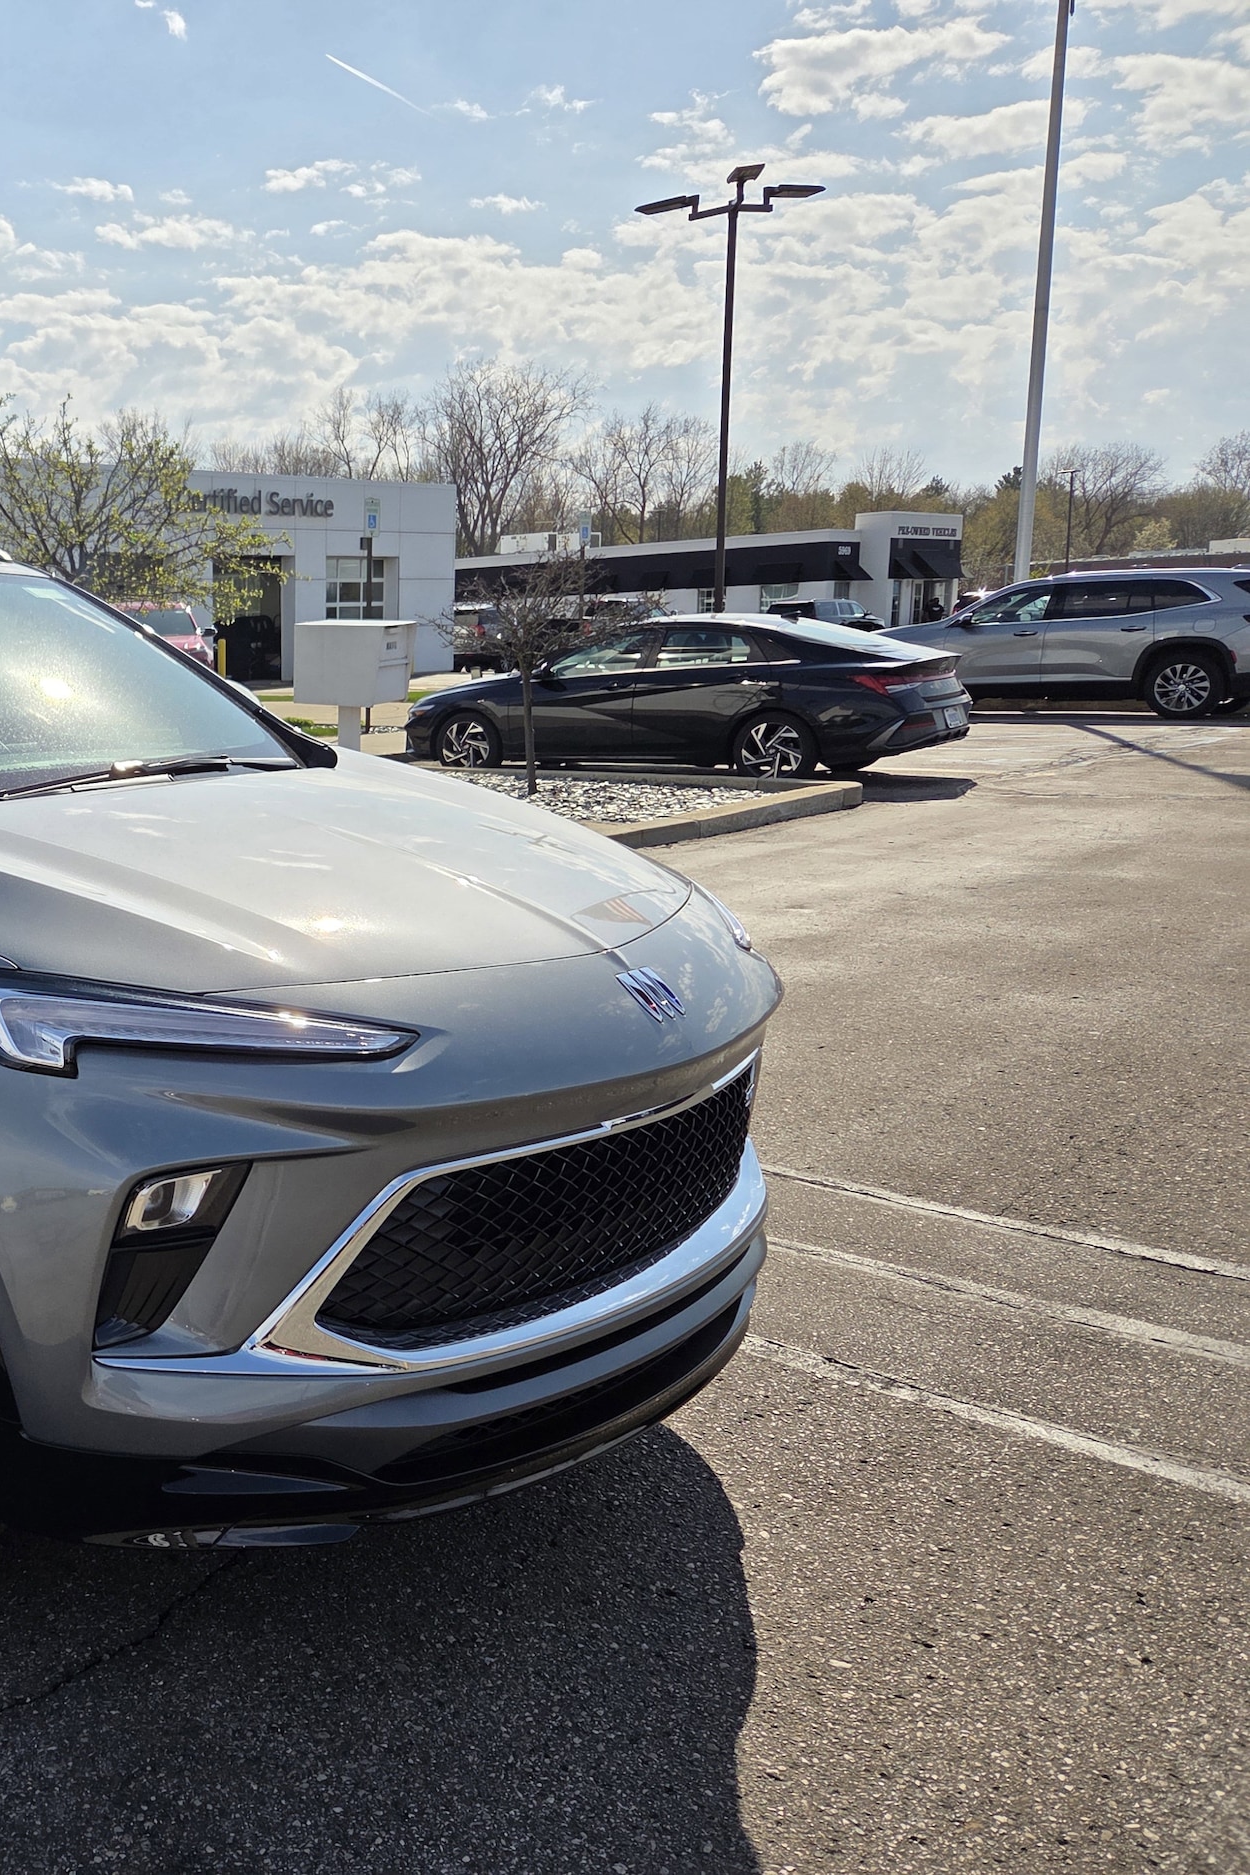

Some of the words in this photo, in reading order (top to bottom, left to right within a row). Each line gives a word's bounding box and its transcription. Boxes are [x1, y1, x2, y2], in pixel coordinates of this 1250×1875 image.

[268, 491, 335, 517] Service
[897, 526, 931, 536] PRE-OWNED
[932, 527, 958, 537] VEHICLES
